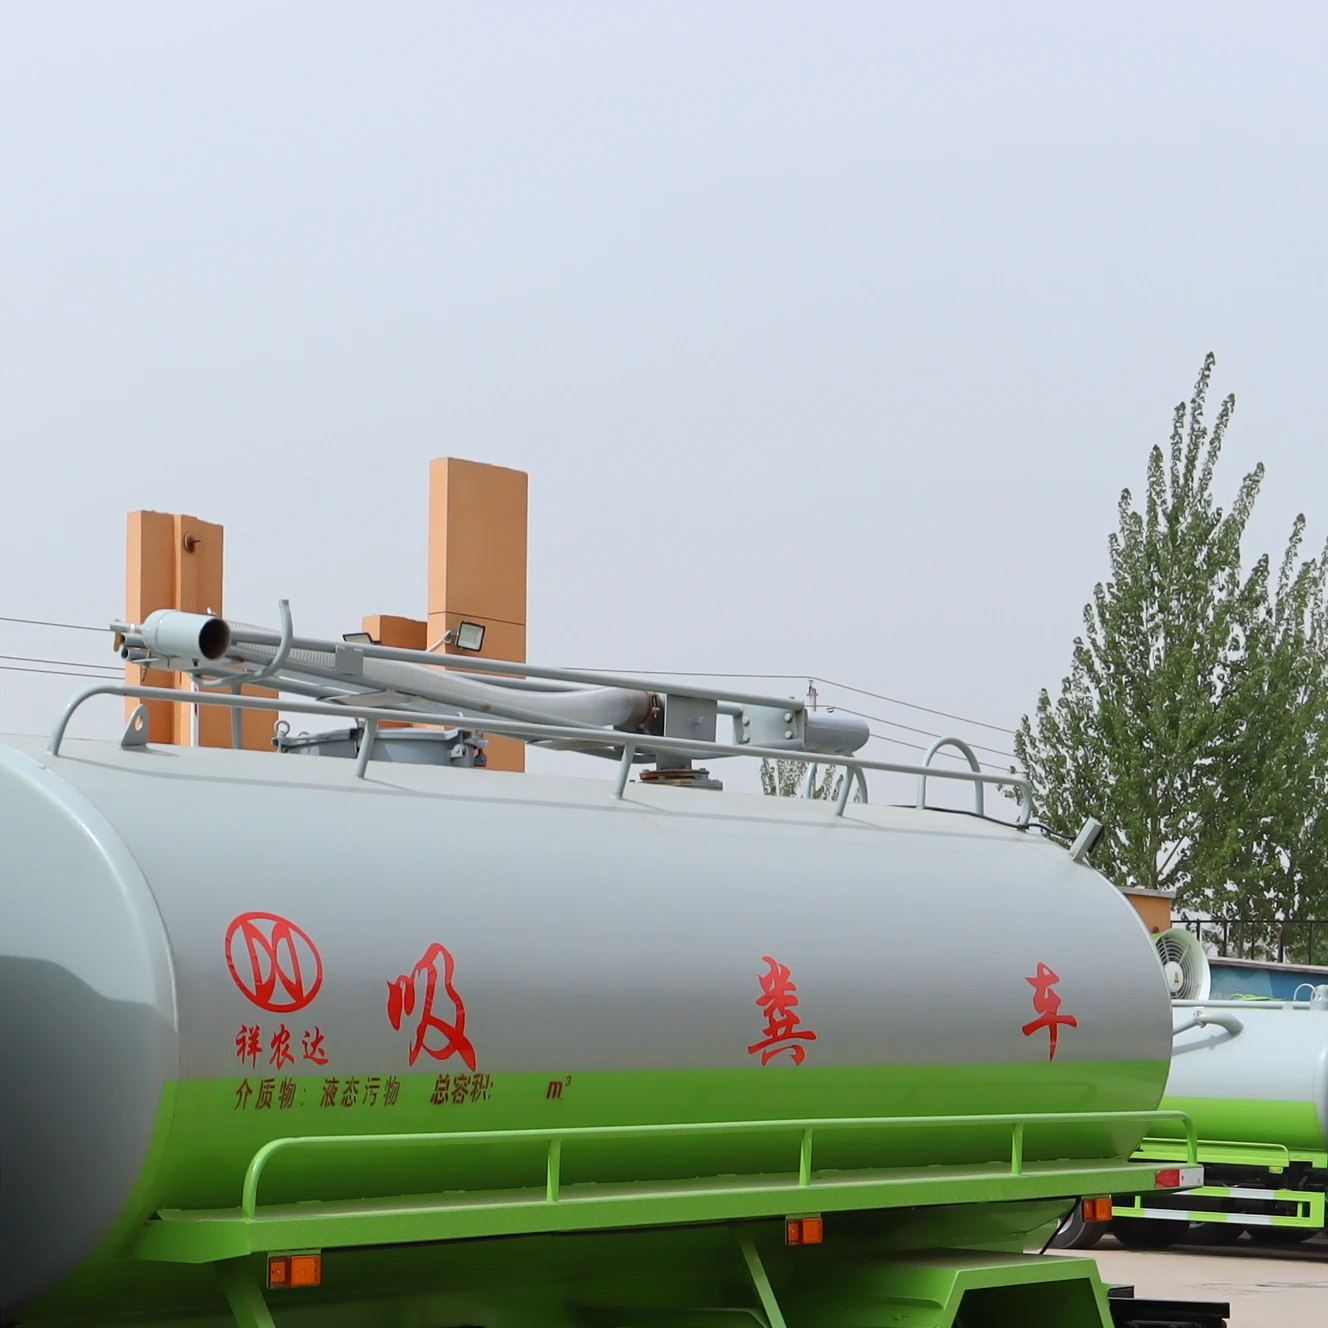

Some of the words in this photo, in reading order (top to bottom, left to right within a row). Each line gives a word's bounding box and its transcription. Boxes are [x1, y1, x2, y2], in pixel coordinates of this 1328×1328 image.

[386, 943, 476, 1072] 吸
[747, 955, 817, 1066] 粪
[1022, 961, 1077, 1063] 车
[234, 1023, 329, 1071] 祥农达
[320, 1075, 400, 1109] 液态污物
